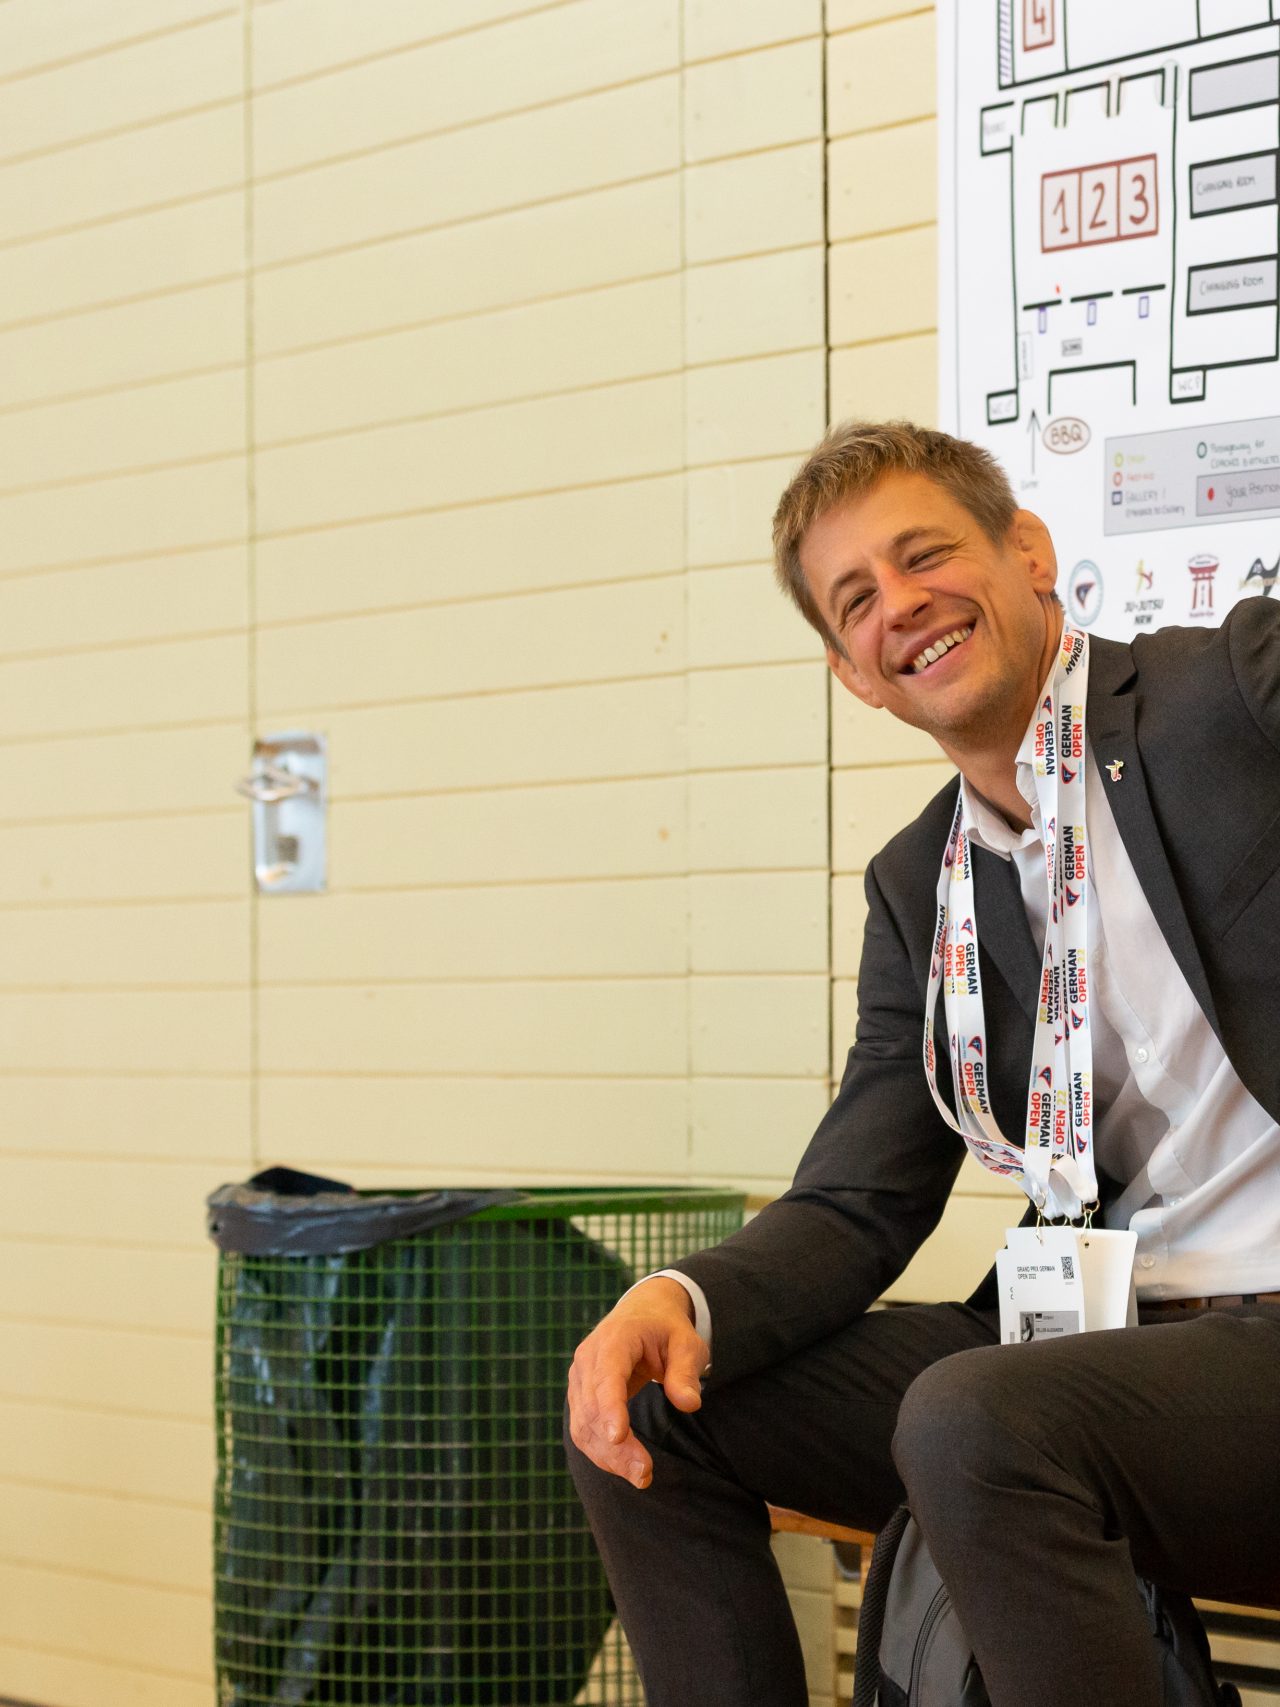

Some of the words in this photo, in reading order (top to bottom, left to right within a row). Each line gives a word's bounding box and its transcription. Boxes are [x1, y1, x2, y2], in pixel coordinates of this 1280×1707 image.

[1032, 0, 1046, 35] 4
[1053, 189, 1070, 234] 1
[1089, 182, 1107, 229] 2
[1129, 174, 1149, 225] 3
[1051, 424, 1082, 445] BBQ
[1065, 638, 1084, 675] GERMAN
[1073, 704, 1083, 719] 22
[1035, 723, 1045, 757] OPEN
[1045, 721, 1055, 776] GERMAN
[1062, 705, 1072, 758] GERMAN
[1073, 724, 1083, 758] OPEN
[1074, 825, 1084, 840] 22
[1063, 826, 1074, 880] GERMAN
[1075, 845, 1085, 880] OPEN
[934, 904, 945, 955] GERMAN
[945, 944, 953, 977] OPEN
[956, 944, 966, 977] OPEN
[966, 943, 978, 995] GERMAN
[1068, 949, 1078, 1004] GERMAN
[957, 980, 968, 995] 22
[1041, 968, 1049, 1004] OPEN
[1078, 968, 1087, 1003] OPEN
[964, 1062, 977, 1096] OPEN
[974, 1062, 990, 1115] GERMAN
[1030, 1092, 1040, 1127] OPEN
[1057, 1090, 1067, 1105] 22
[1074, 1072, 1082, 1127] GERMAN
[1083, 1091, 1091, 1127] OPEN
[1040, 1093, 1051, 1147] GERMAN
[1056, 1109, 1066, 1145] OPEN
[1028, 1130, 1039, 1148] 22
